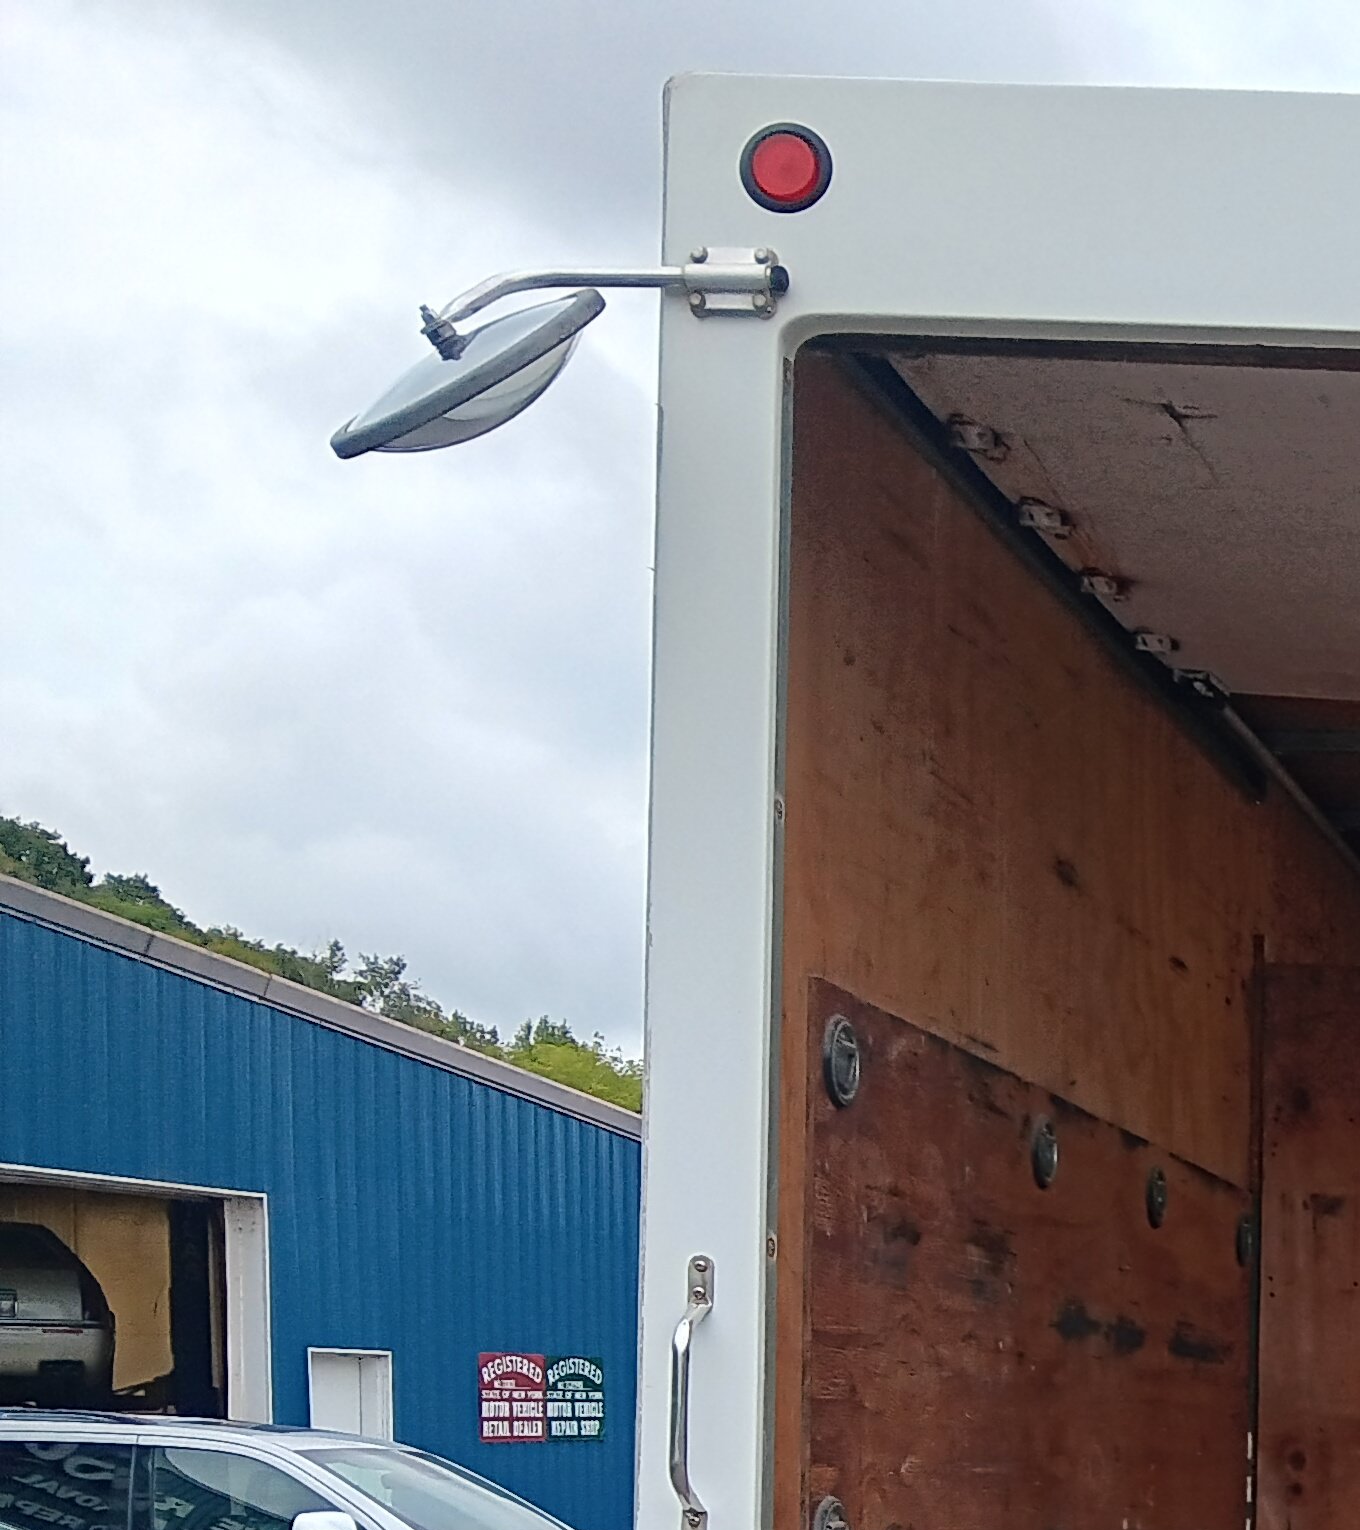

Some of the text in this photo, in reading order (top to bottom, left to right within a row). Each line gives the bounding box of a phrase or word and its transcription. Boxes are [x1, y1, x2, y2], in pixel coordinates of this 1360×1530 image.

[482, 1355, 543, 1384] REGISTERED
[547, 1358, 603, 1386] REGISTERED
[481, 1401, 544, 1417] MOTOR VEHICLE
[547, 1401, 604, 1417] MOTOR VEHICLE
[482, 1420, 543, 1437] RETAIL DEALER
[551, 1420, 601, 1436] REPAIR SHOP
